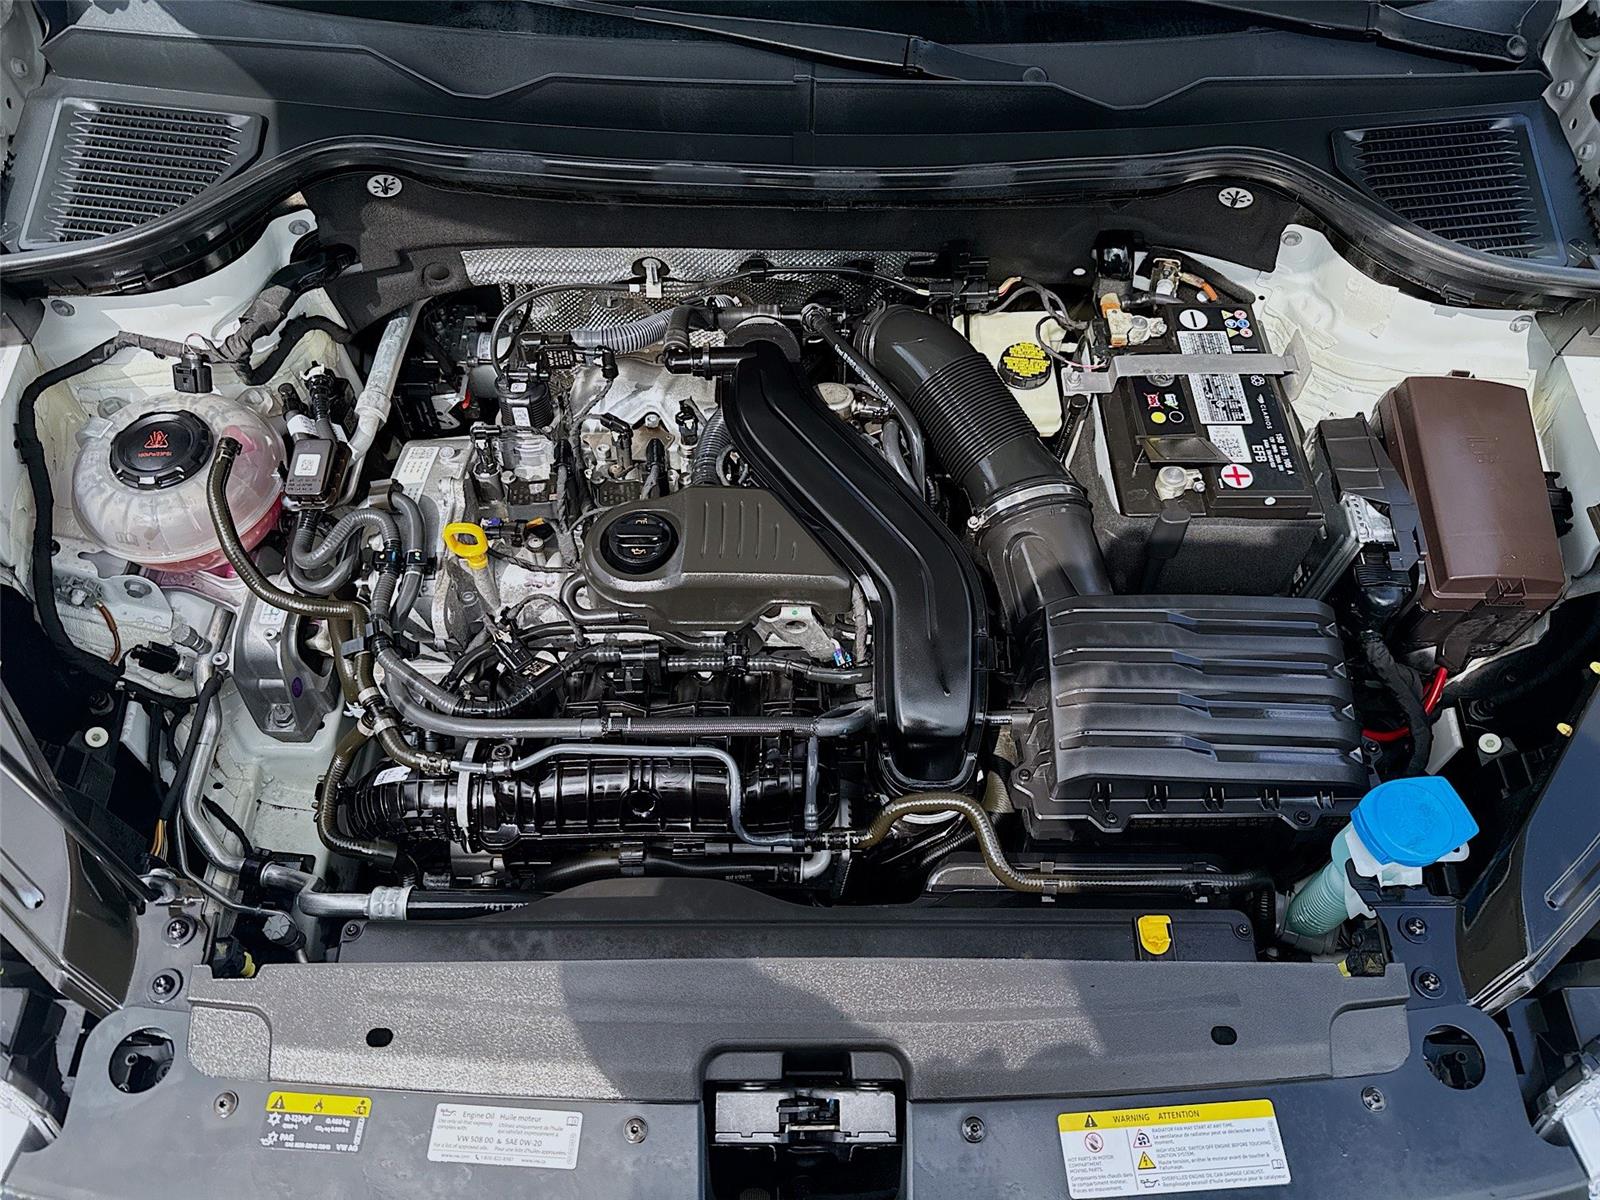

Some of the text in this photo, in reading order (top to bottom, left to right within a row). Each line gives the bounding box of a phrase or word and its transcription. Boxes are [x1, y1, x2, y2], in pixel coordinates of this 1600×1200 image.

[1260, 404, 1273, 430] CLARIOS
[1252, 444, 1268, 463] EFB
[462, 1110, 484, 1120] Engine
[1112, 1109, 1200, 1124] WARNING ATTENTION
[279, 1132, 295, 1142] PAG
